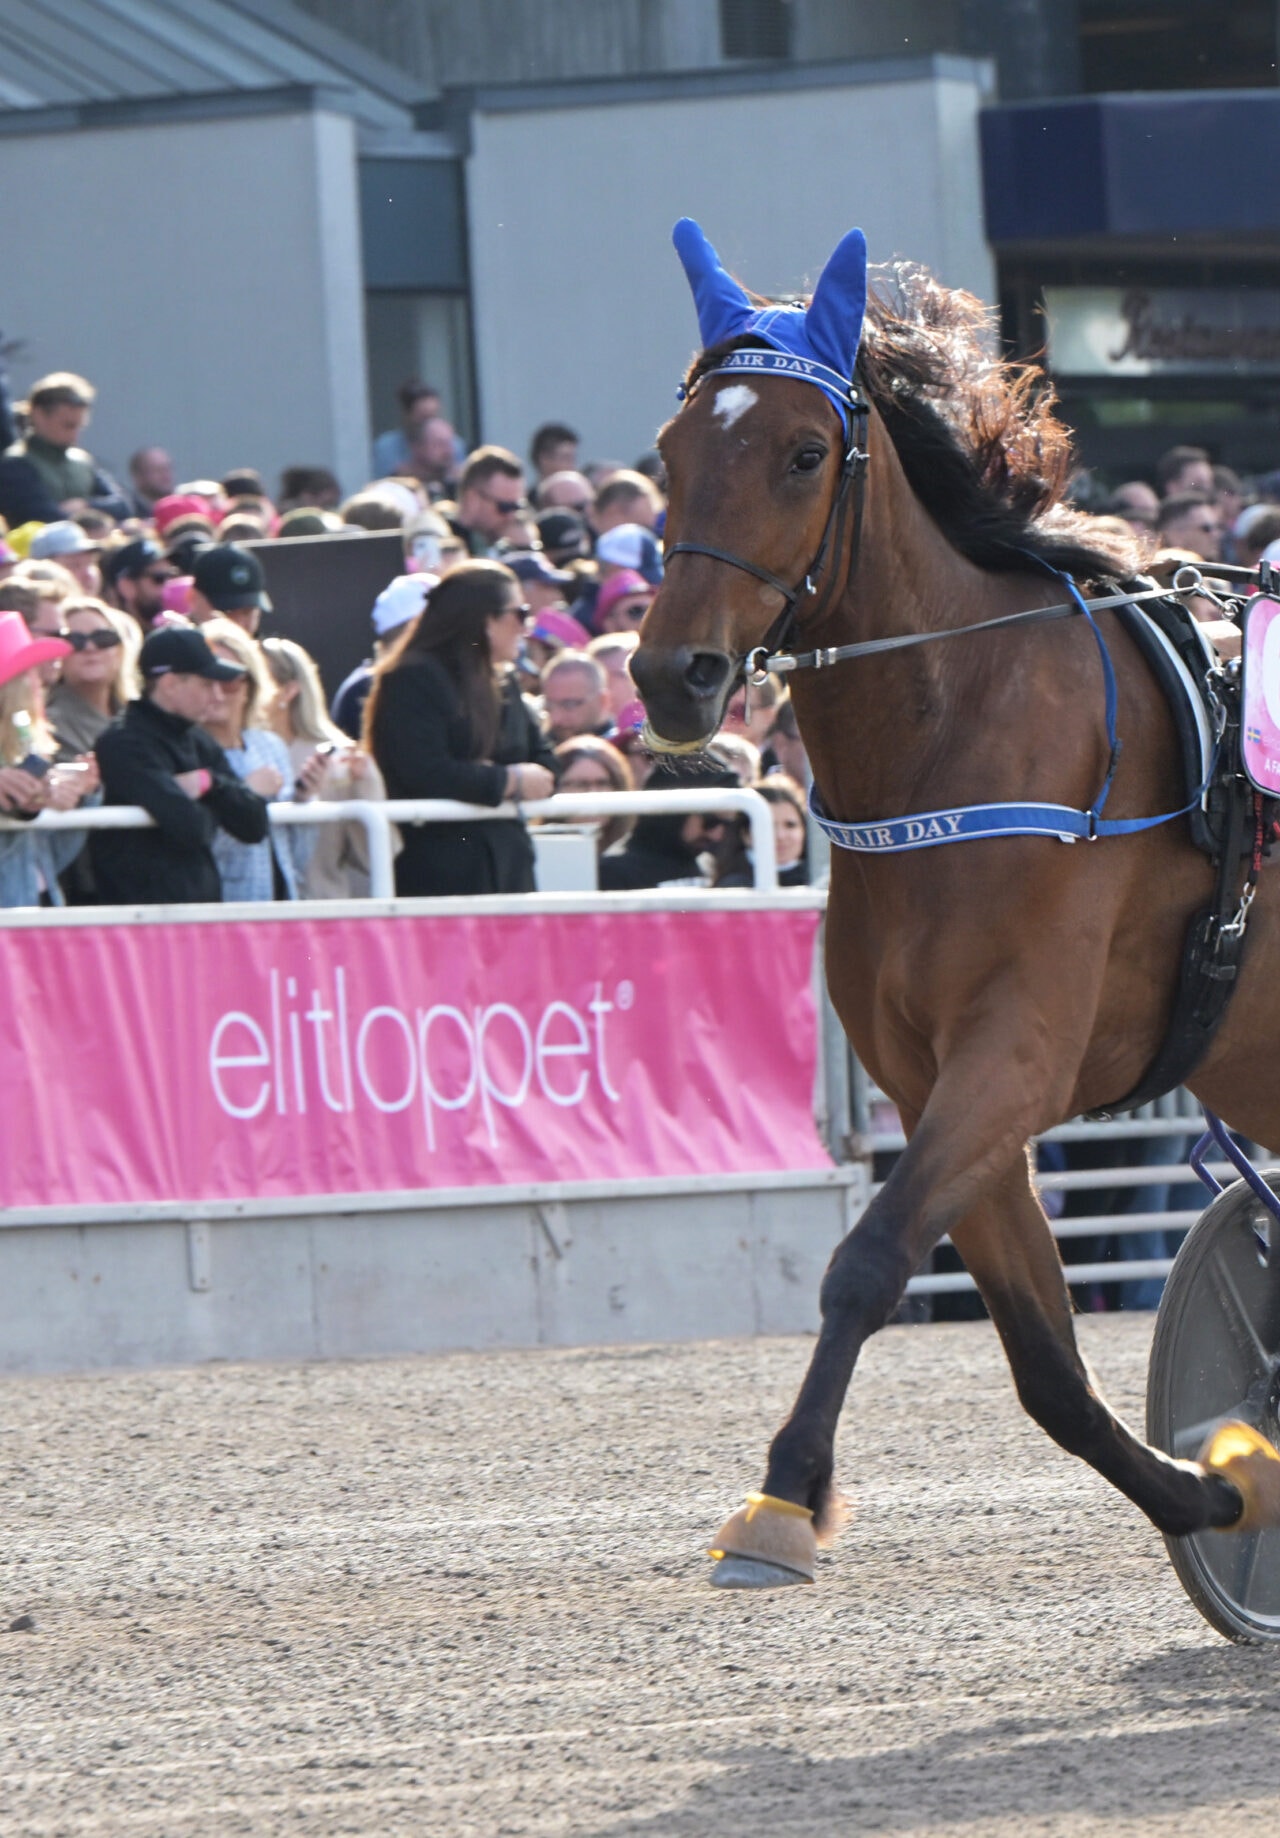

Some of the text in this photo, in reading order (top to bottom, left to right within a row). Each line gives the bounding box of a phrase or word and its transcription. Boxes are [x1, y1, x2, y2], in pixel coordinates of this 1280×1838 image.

[773, 356, 816, 374] DAY
[1264, 757, 1272, 772] A
[828, 814, 965, 848] A FAIR DAY
